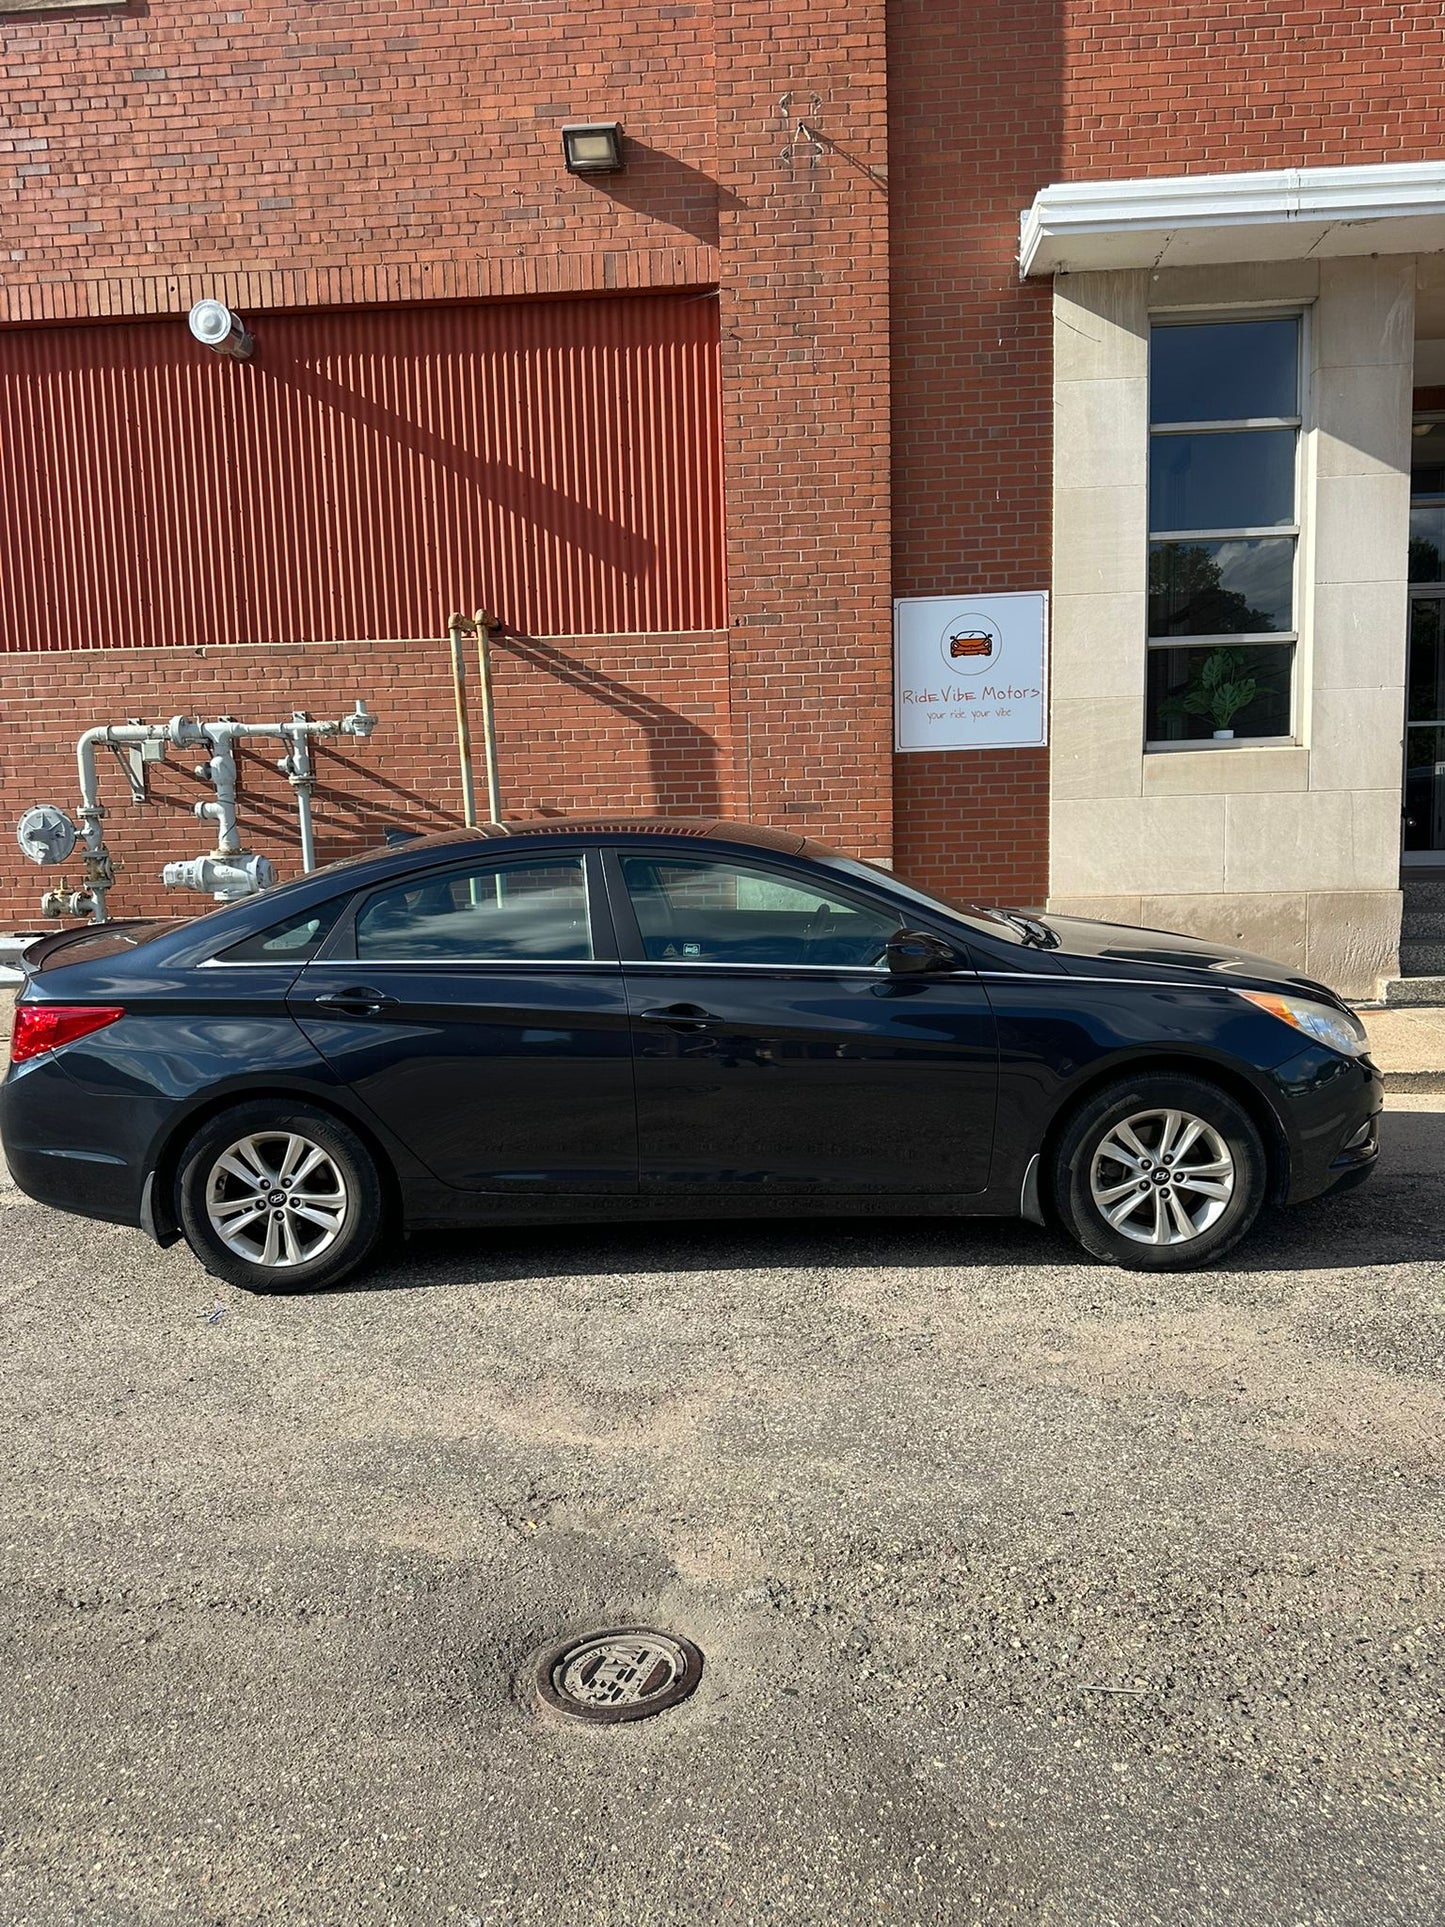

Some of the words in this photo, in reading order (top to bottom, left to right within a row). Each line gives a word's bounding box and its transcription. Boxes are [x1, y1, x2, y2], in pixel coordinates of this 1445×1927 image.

[982, 685, 1040, 701] Motors
[926, 712, 946, 724] your
[970, 709, 990, 723] your
[995, 707, 1012, 717] vibe
